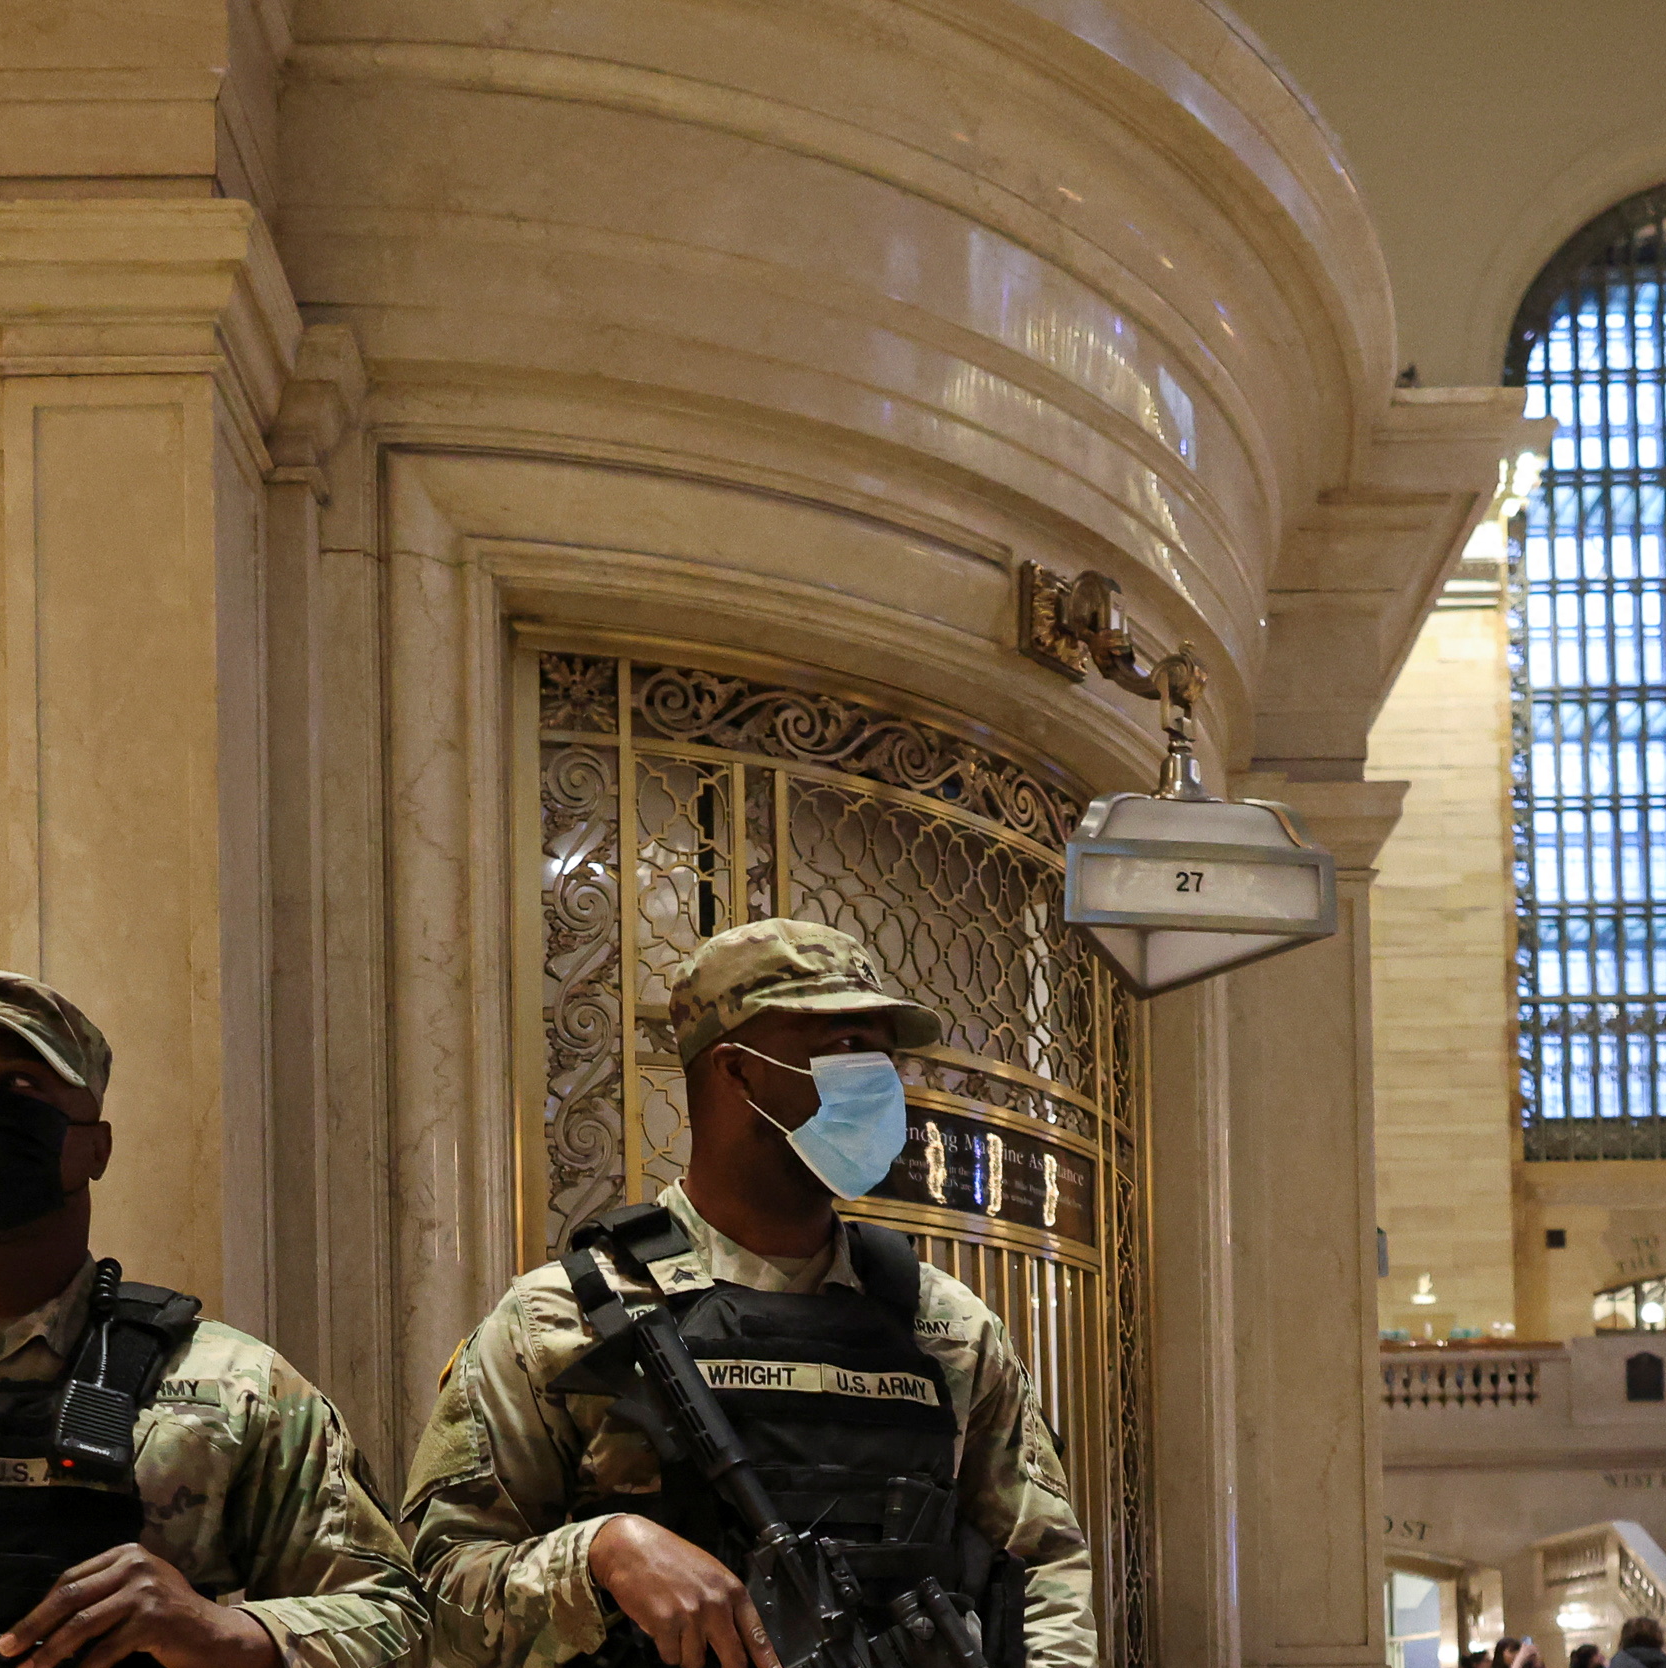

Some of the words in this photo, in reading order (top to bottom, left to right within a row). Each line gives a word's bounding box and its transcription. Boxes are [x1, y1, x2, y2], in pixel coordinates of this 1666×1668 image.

[1176, 871, 1204, 893] 27
[707, 1365, 796, 1387] WRIGHT
[836, 1371, 871, 1395] U.S.
[877, 1376, 927, 1400] ARMY
